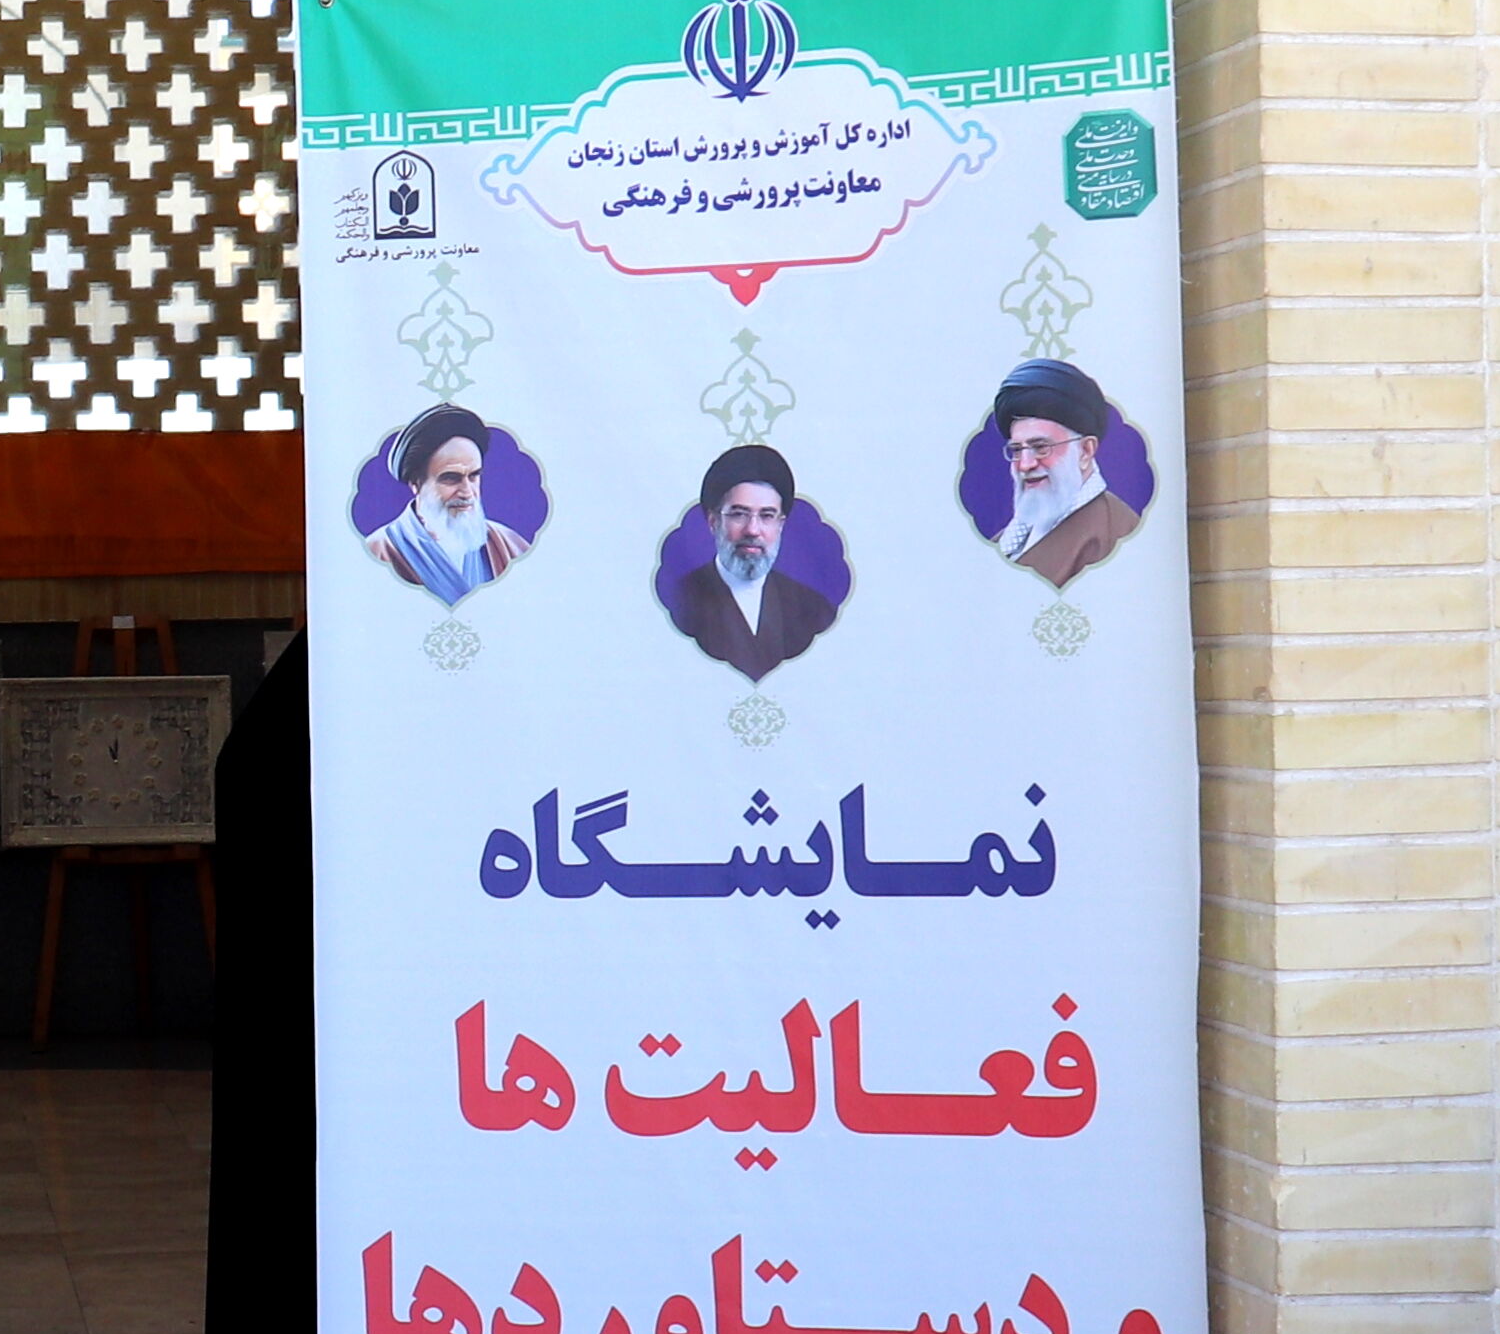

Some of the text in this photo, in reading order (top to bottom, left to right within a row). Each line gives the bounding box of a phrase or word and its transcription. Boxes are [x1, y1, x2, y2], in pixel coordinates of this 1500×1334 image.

[568, 119, 911, 168] اداره کل آموزش و پرورش استان زنجان
[603, 169, 881, 217] معاونت پرورشی و فرهنگی
[336, 246, 379, 263] فرهنگی
[391, 246, 437, 260] پرورشی
[440, 243, 480, 258] معاونت
[479, 782, 1058, 930] نمایشگاه
[604, 992, 1098, 1172] فعالیت
